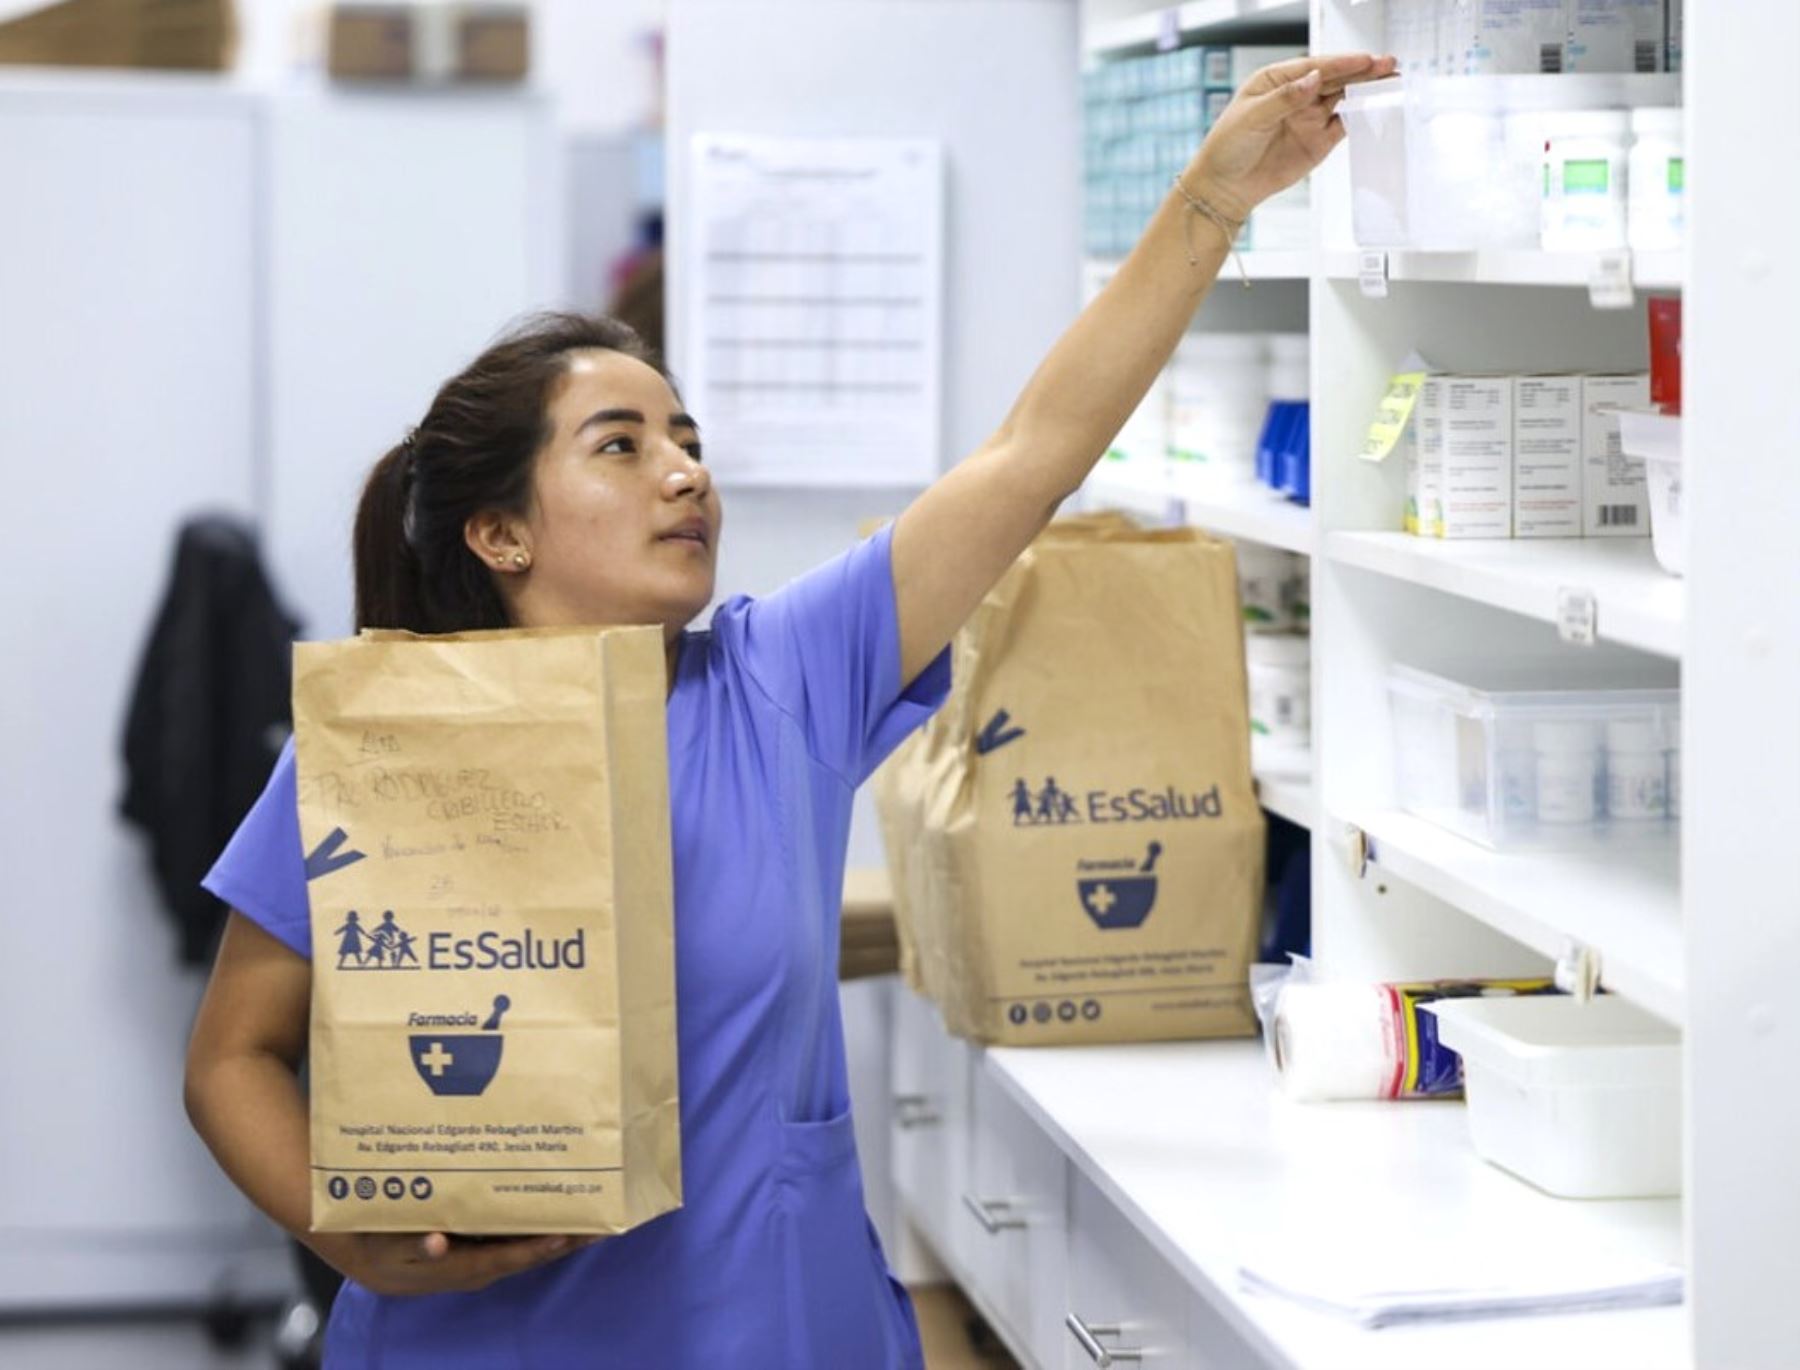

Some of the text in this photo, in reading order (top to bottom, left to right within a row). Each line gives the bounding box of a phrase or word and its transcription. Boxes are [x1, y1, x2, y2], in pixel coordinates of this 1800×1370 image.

[1088, 784, 1222, 822] EsSalud
[428, 928, 585, 970] EsSalud
[407, 1011, 478, 1028] Farmacia
[340, 1124, 384, 1137] Hospital
[387, 1124, 435, 1136] Nacional
[437, 1124, 482, 1137] Edgardo
[376, 1141, 420, 1154] Edgardo
